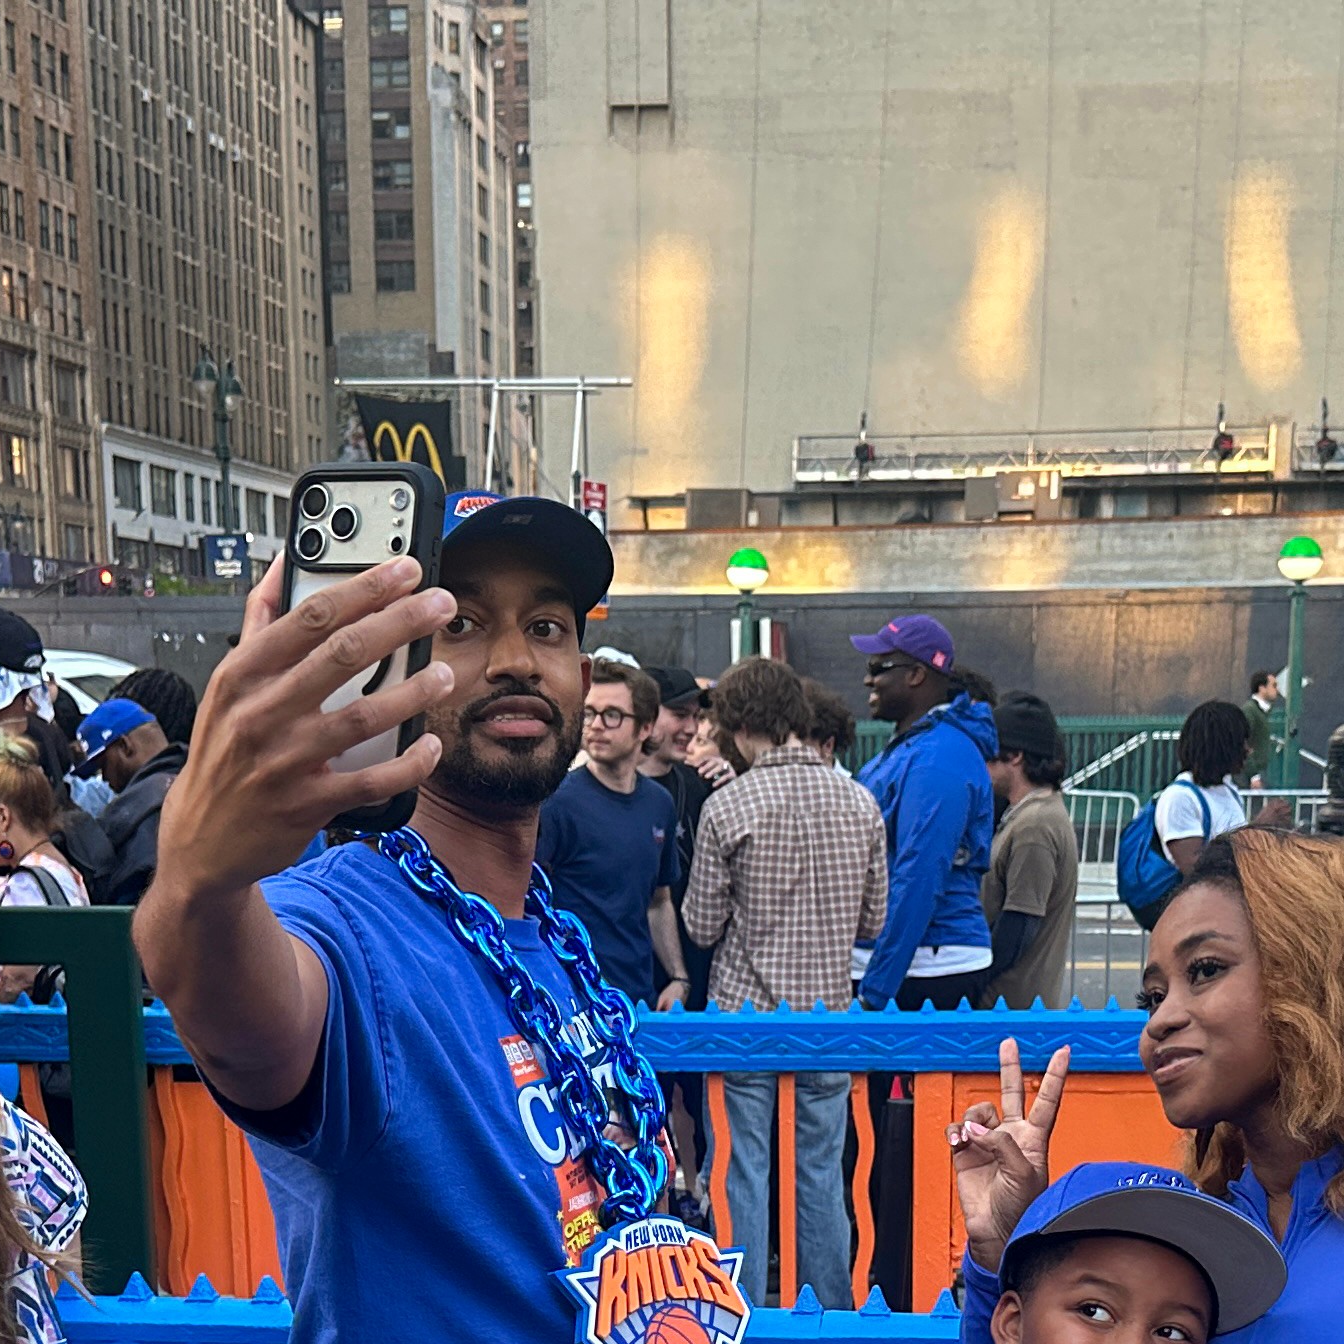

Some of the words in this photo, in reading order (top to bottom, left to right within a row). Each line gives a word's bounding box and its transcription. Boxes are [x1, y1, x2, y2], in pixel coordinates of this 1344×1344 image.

[625, 1225, 651, 1252] NEW
[652, 1224, 686, 1245] YORK
[596, 1237, 746, 1339] KNICKS
